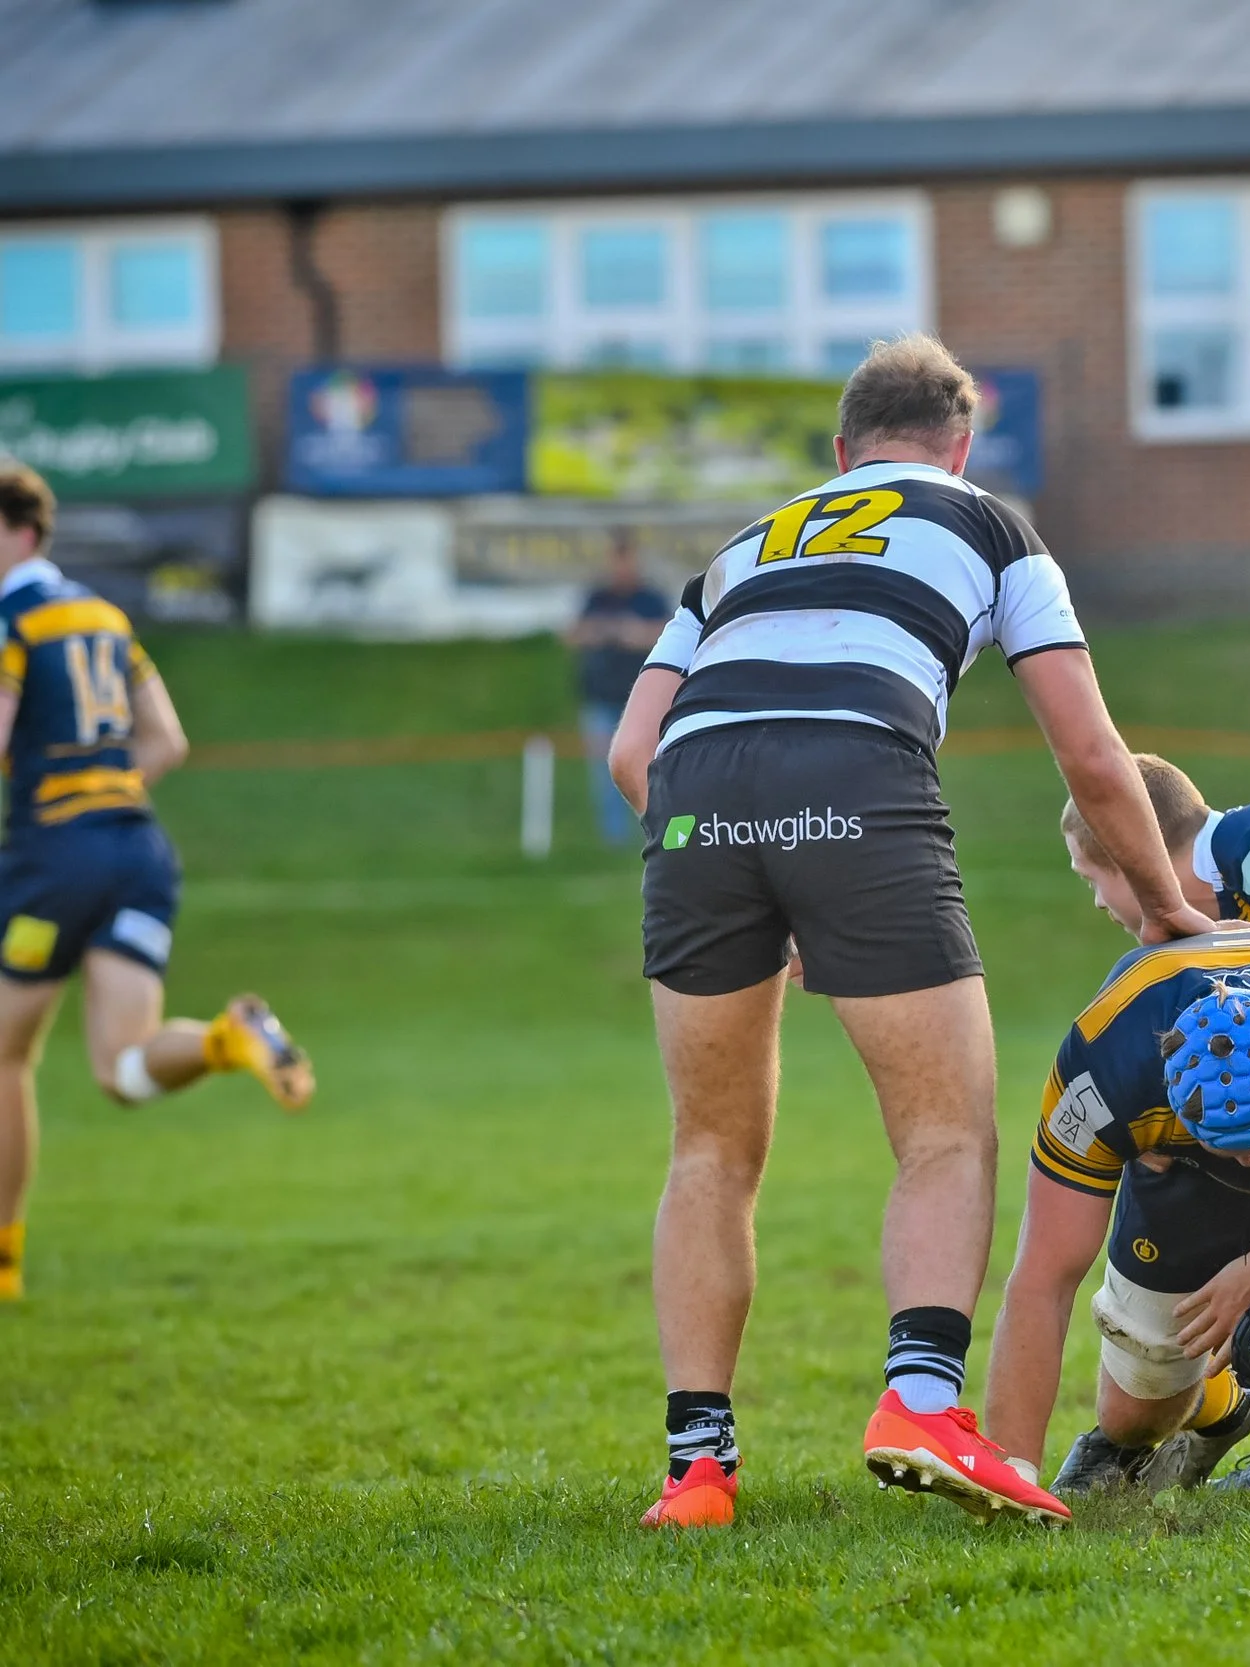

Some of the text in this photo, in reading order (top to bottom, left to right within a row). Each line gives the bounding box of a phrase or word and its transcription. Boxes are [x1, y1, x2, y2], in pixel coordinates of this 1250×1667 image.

[755, 489, 905, 566] 12
[64, 634, 133, 747] 14
[698, 806, 863, 851] shawgibbs
[1057, 1110, 1080, 1144] PA
